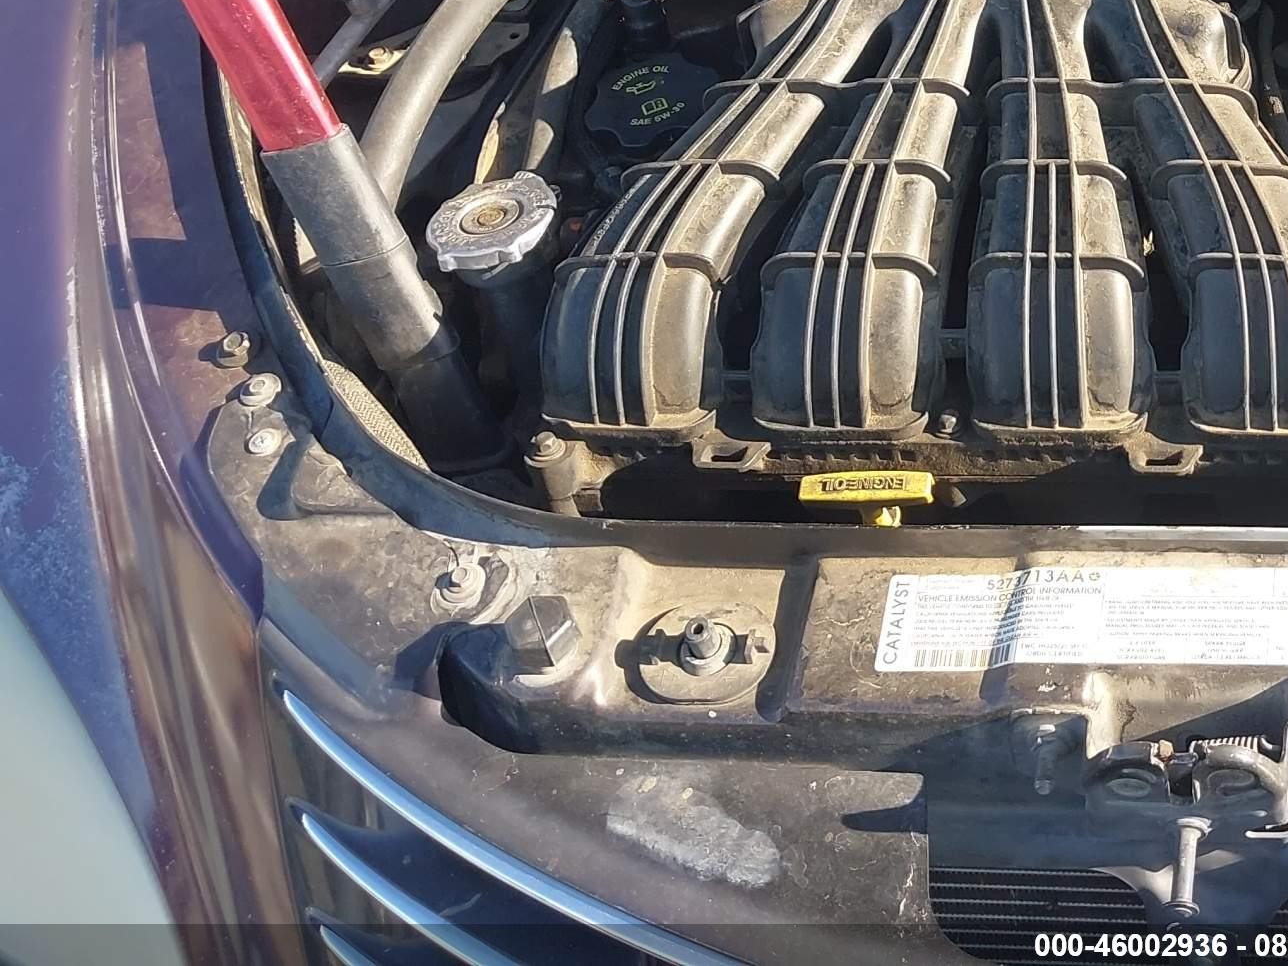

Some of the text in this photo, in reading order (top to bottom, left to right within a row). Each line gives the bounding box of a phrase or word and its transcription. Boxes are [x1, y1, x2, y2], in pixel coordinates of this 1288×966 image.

[612, 65, 670, 91] ENGINE OIL
[630, 118, 652, 126] SAE
[846, 476, 906, 490] ENGINE
[918, 586, 1102, 602] VEHICLE EMISSION CONTROL INFORMATION
[883, 582, 909, 664] CATALYST
